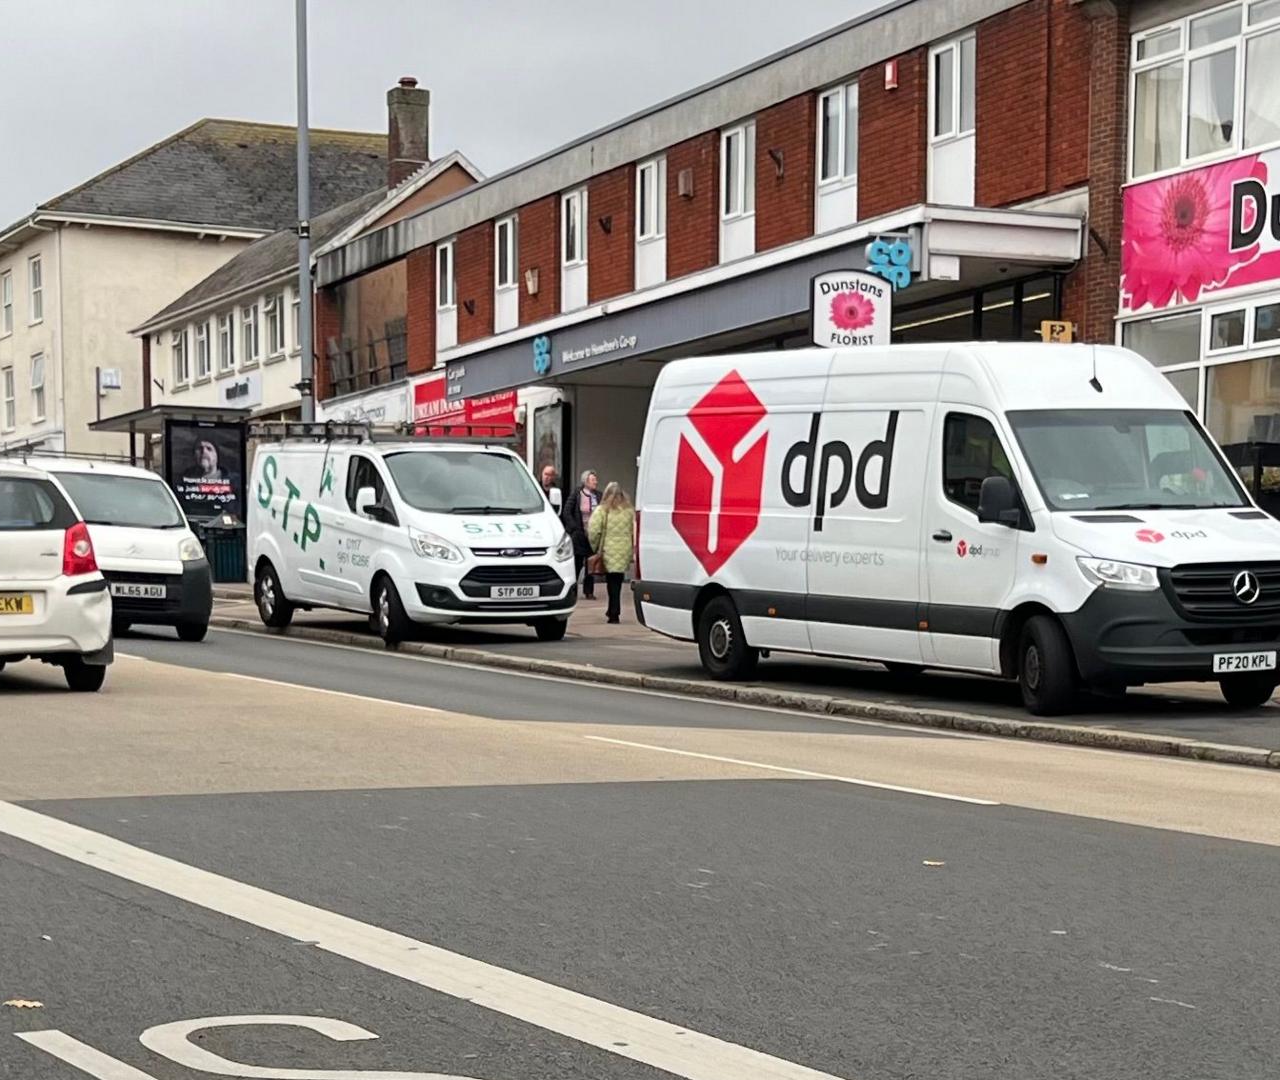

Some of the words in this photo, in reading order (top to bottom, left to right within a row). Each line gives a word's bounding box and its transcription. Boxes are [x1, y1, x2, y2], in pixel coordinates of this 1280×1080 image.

[819, 278, 884, 299] Dunstans
[830, 332, 874, 346] FLORIST
[780, 410, 900, 532] dpd
[1170, 529, 1208, 540] dpd
[776, 546, 799, 562] Your
[799, 547, 841, 568] delivery
[842, 551, 885, 567] experts
[497, 586, 515, 597] STP
[516, 586, 534, 597] 600
[1218, 656, 1249, 670] PF20
[1251, 654, 1272, 668] KPL
